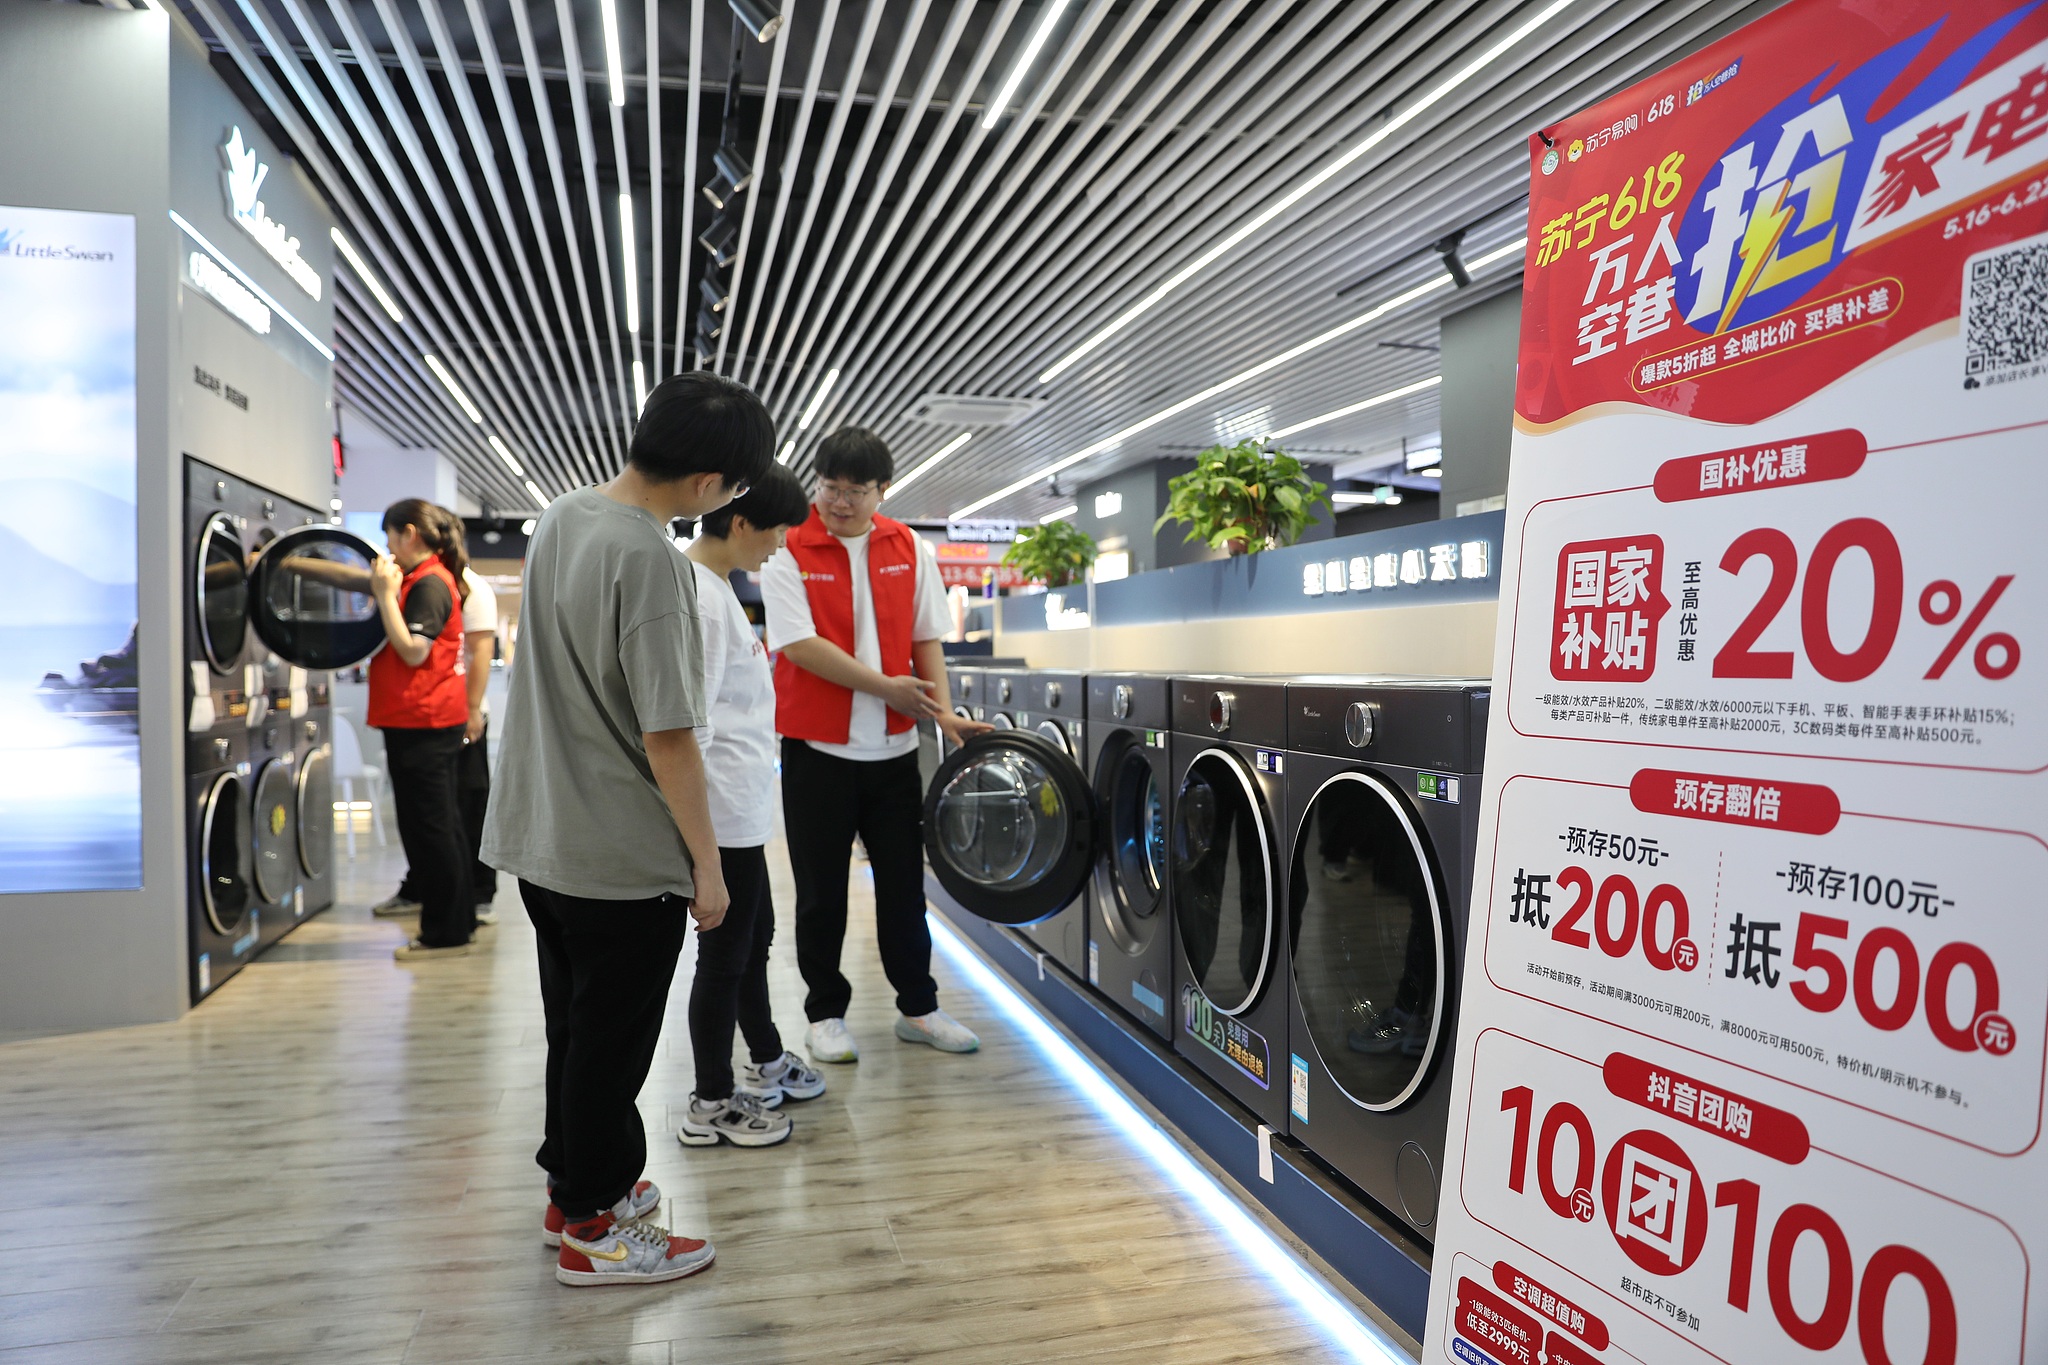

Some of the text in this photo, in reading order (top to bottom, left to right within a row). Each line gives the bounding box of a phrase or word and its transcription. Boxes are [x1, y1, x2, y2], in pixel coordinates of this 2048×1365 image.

[1586, 113, 1638, 153] 苏宁易购
[1647, 94, 1675, 123] 618
[1535, 150, 1686, 267] 苏宁618
[1684, 93, 1854, 332] 抢
[1581, 216, 1682, 306] 万人
[1573, 276, 1677, 366] 空巷
[1640, 287, 1890, 386] 爆款5折起 全城比价 买贵补差
[1700, 444, 1808, 491] 国补优惠
[1564, 545, 1653, 609] 国家
[1712, 516, 2021, 683] 20%
[1560, 612, 1649, 671] 补贴
[1677, 561, 1702, 662] 至高优惠
[1673, 778, 1782, 822] 预存翻倍
[1647, 1073, 1753, 1139] 抖音团购
[1513, 1276, 1585, 1335] 空调超值购
[1620, 1275, 1701, 1333] 超市店不可参加
[1466, 1312, 1530, 1365] 低至2999元
